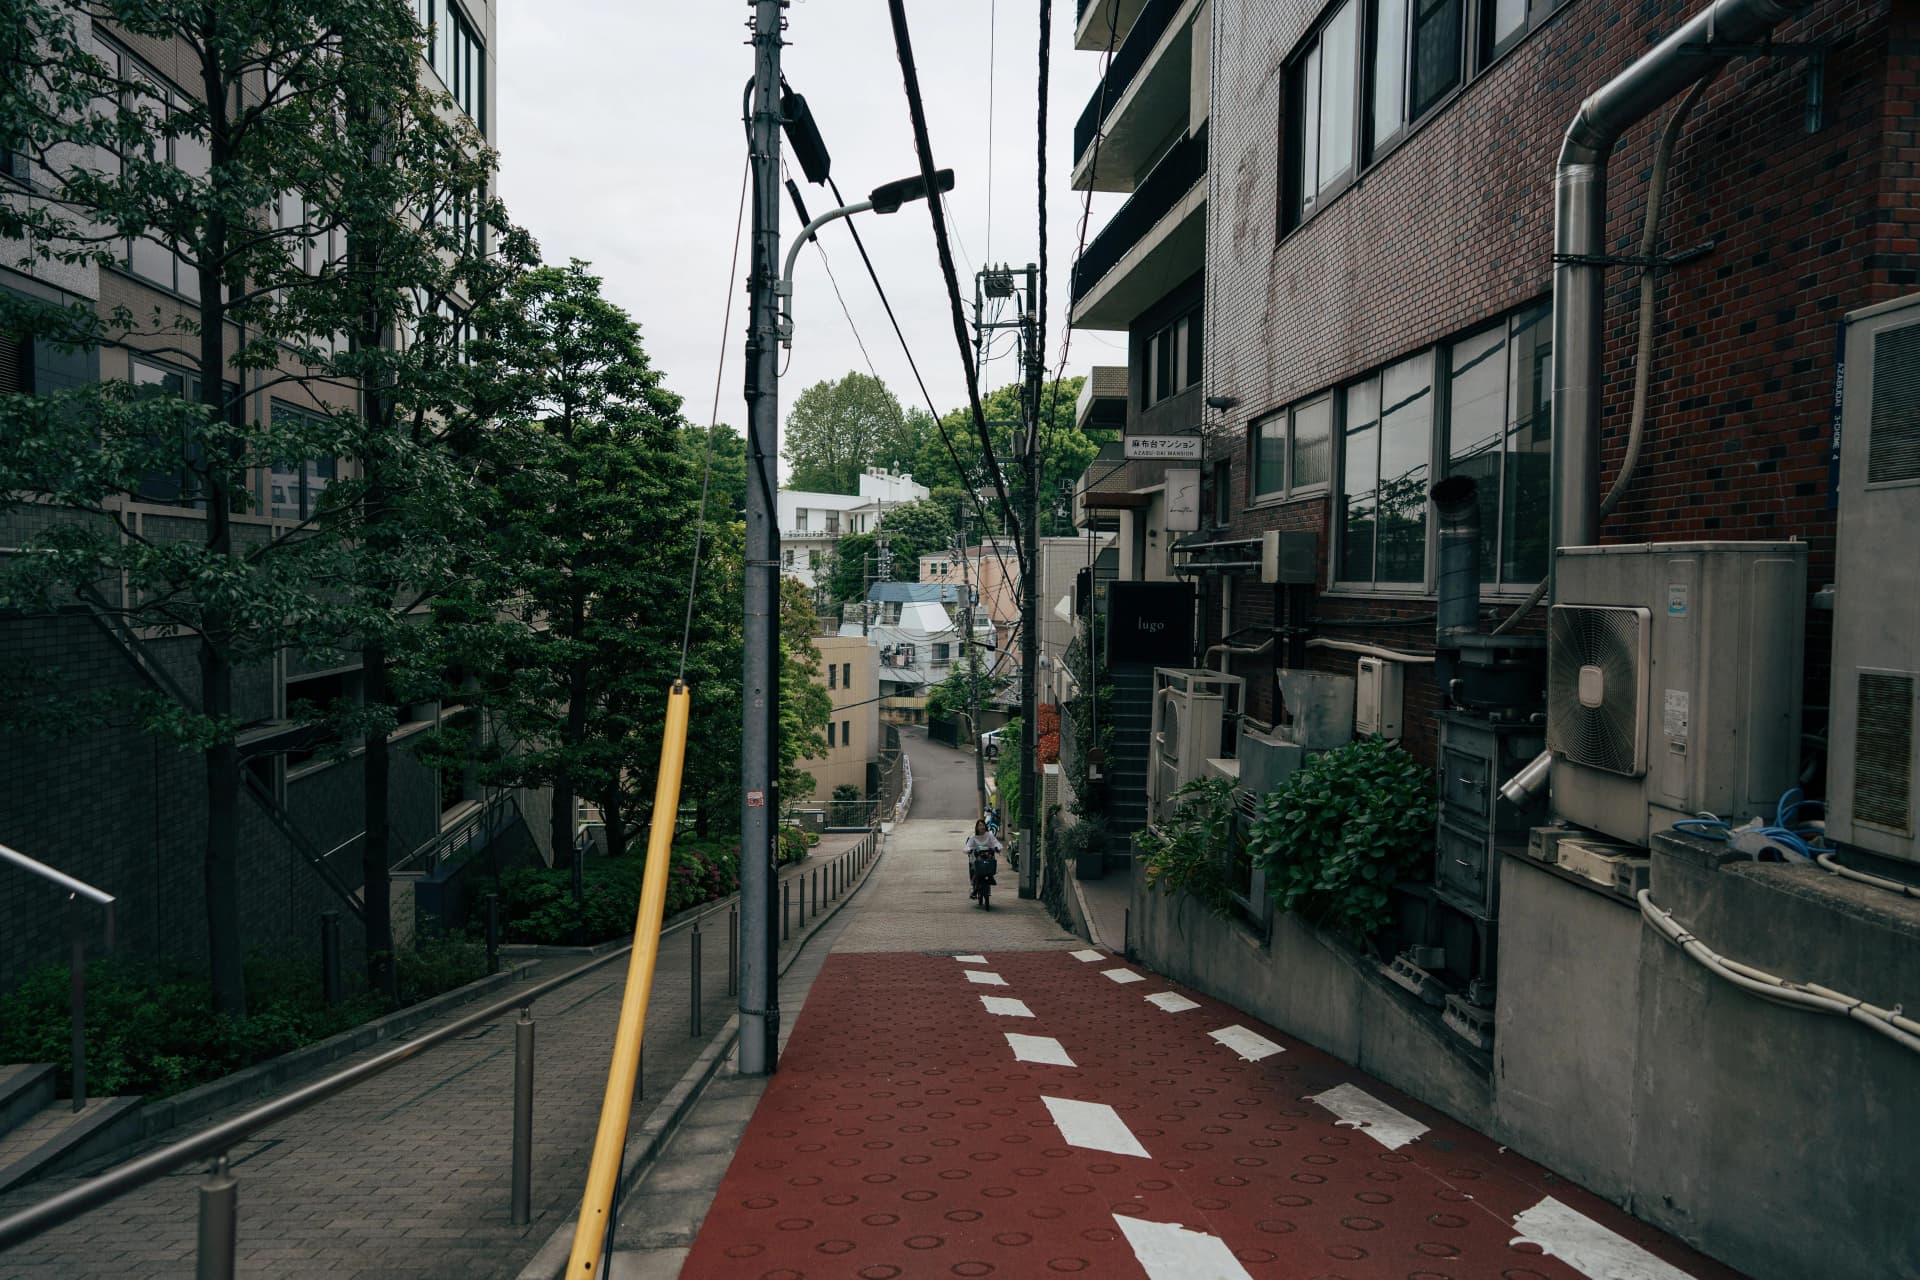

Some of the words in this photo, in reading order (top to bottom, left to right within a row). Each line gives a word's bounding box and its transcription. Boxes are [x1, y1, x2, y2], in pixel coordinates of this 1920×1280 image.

[1835, 363, 1843, 407] AZABUDAI
[1132, 439, 1195, 449] 麻布台マンション
[1833, 415, 1841, 448] 3-CHOME
[1138, 615, 1164, 633] lugo
